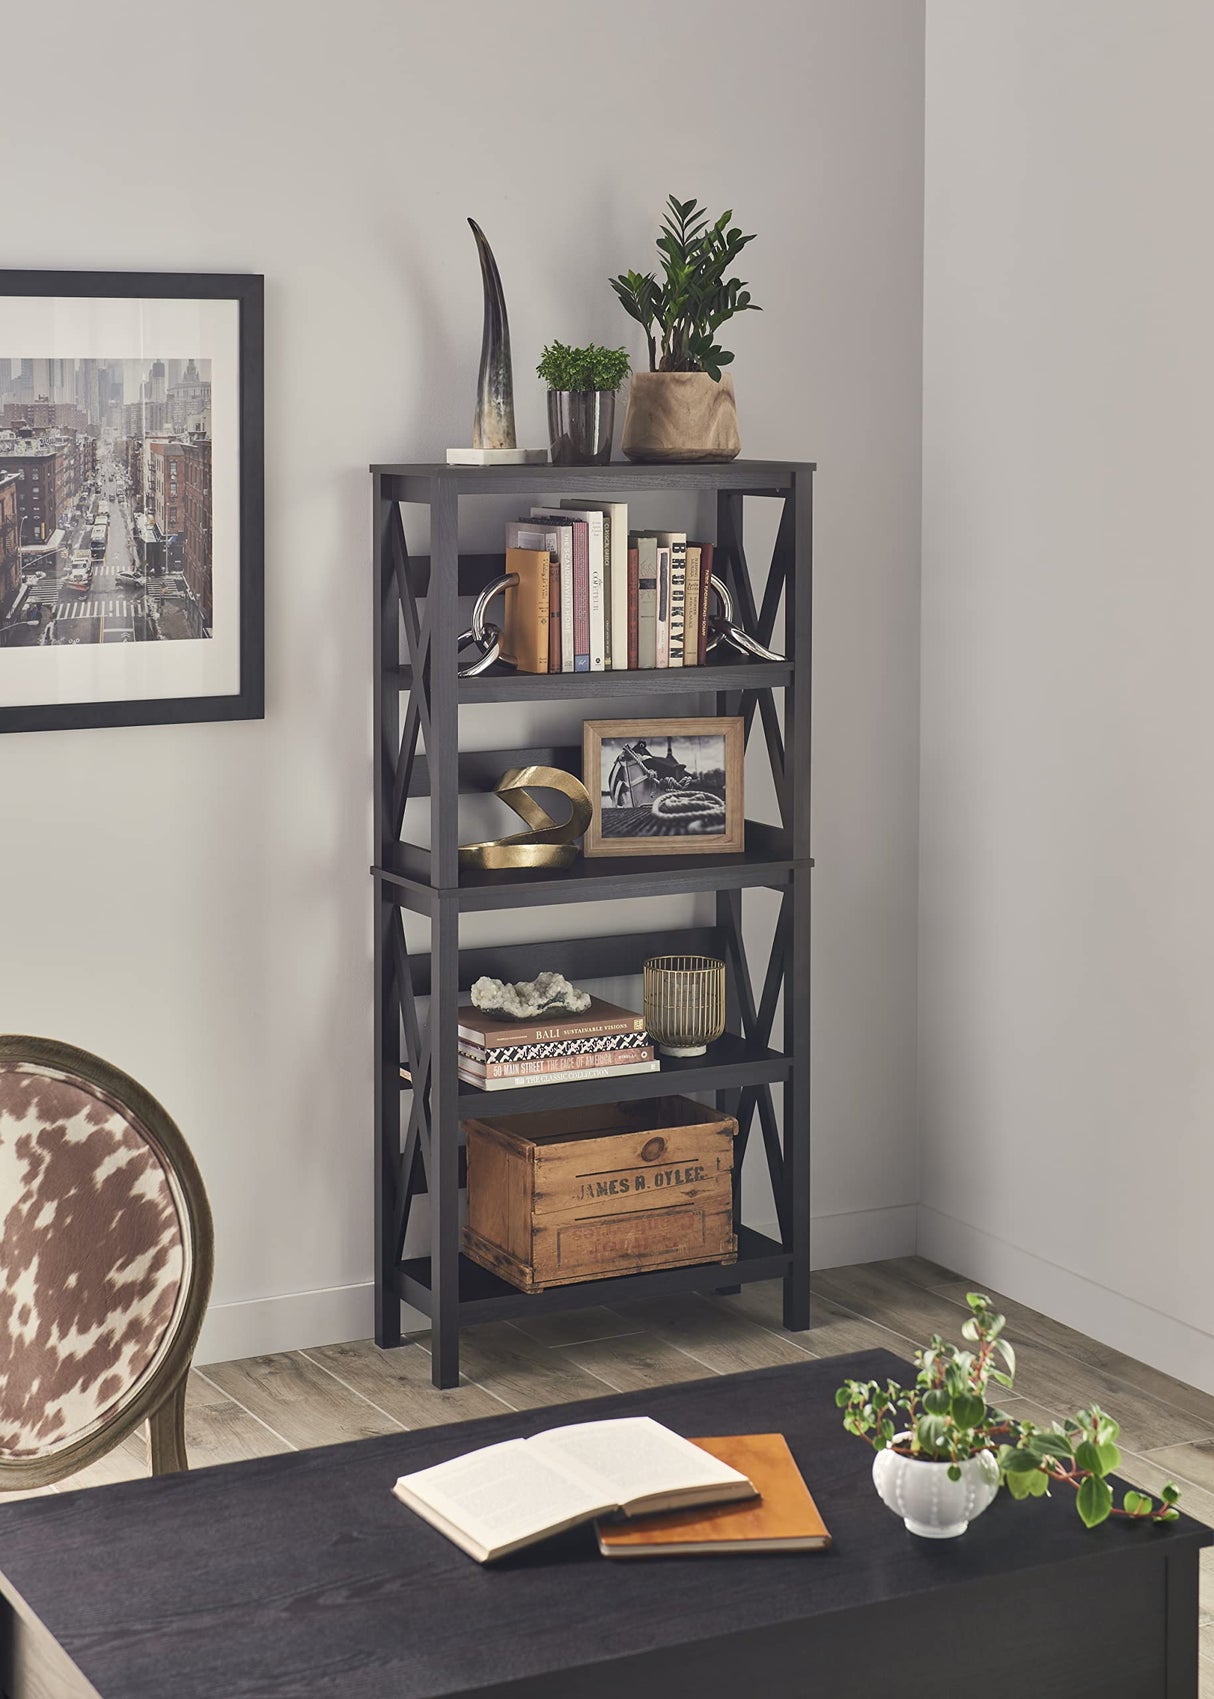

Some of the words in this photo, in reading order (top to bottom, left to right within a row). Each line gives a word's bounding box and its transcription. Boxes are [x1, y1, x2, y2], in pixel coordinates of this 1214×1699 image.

[671, 543, 685, 658] BROOKLYN
[564, 610, 572, 633] HOME
[536, 1029, 560, 1040] BALI
[563, 1026, 603, 1035] SUSTAINABLE
[604, 1023, 628, 1031] VISIONS
[493, 1065, 502, 1077] 50
[503, 1063, 520, 1076] MAIN
[520, 1060, 545, 1074] STREET
[546, 1058, 561, 1071] THE
[561, 1056, 575, 1069] FACE
[575, 1054, 585, 1067] OF
[585, 1052, 613, 1066] AMERICA
[527, 1076, 541, 1084] THE
[541, 1072, 568, 1083] CLASSIC
[568, 1068, 609, 1081] COLLECTION
[580, 1178, 630, 1200] JAMES
